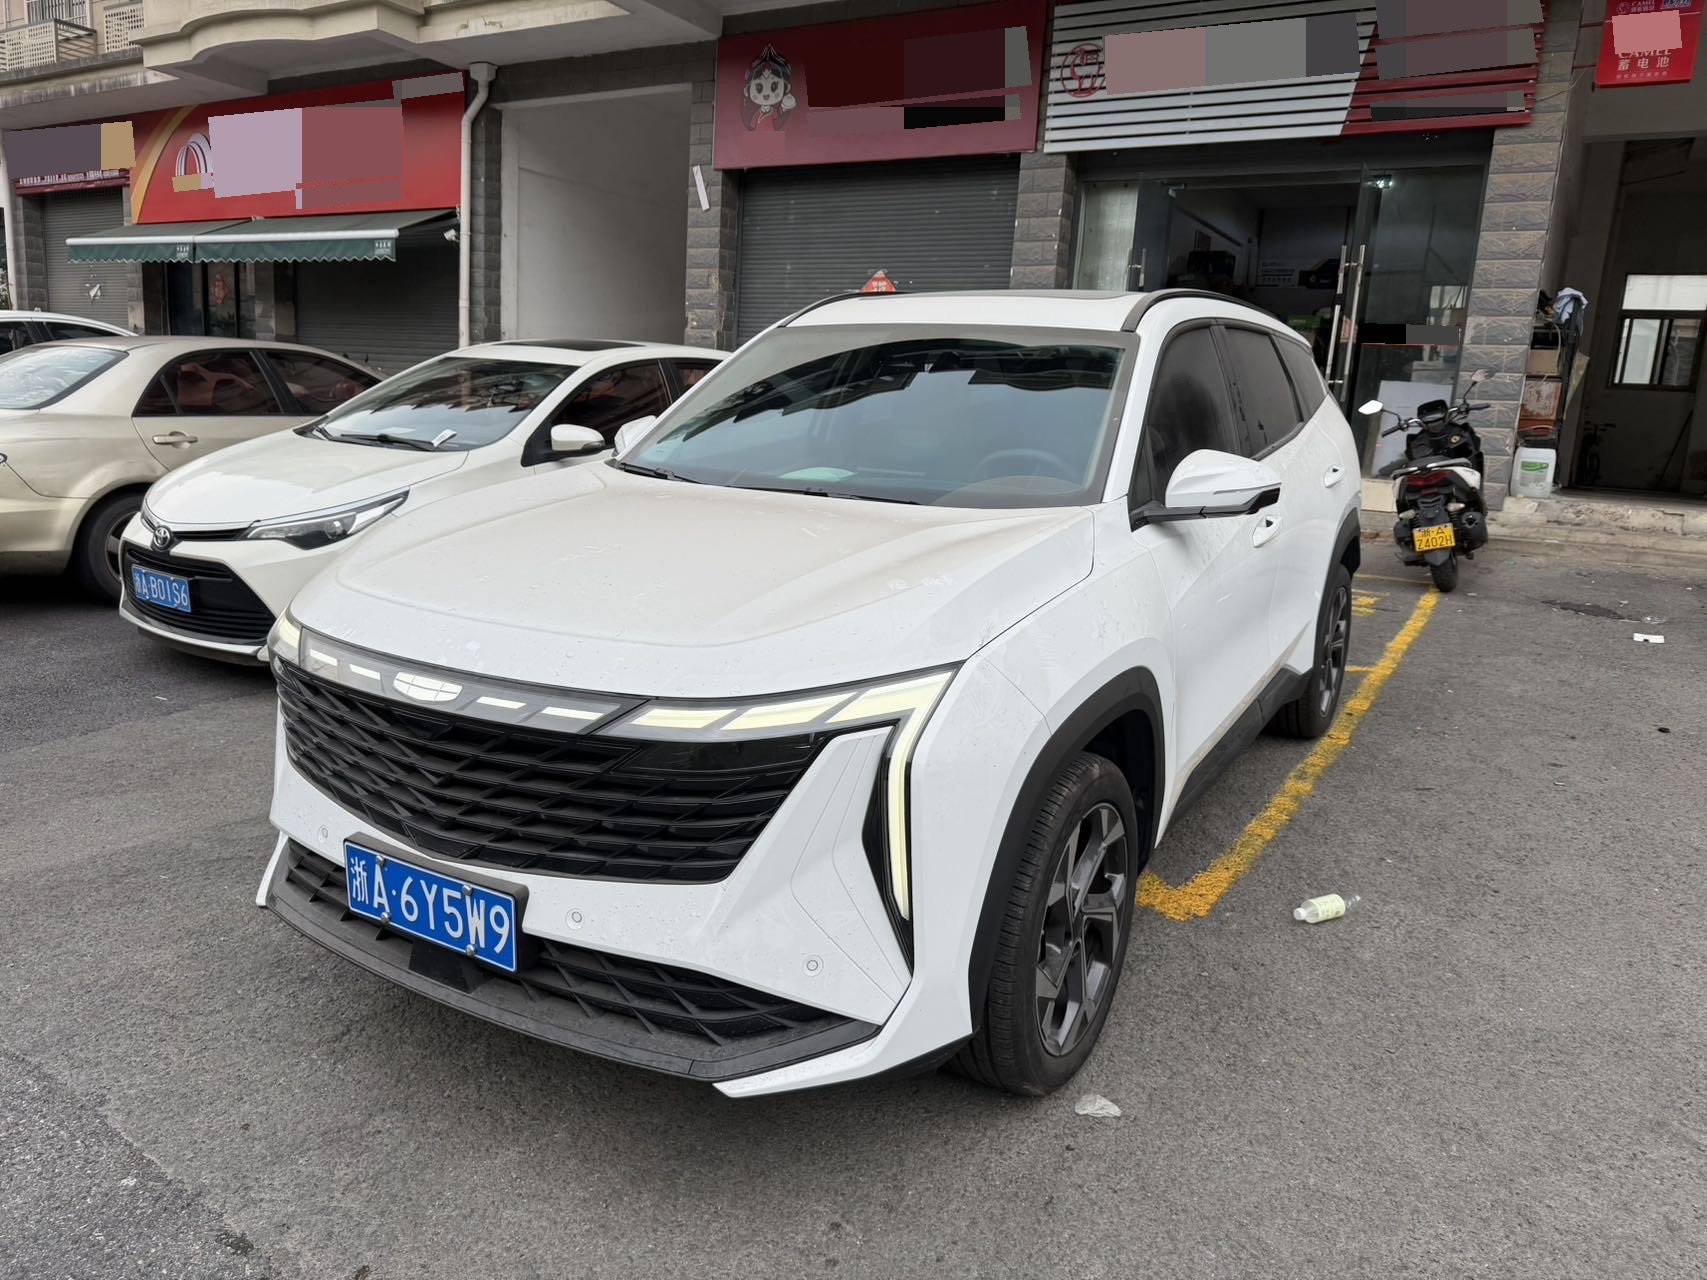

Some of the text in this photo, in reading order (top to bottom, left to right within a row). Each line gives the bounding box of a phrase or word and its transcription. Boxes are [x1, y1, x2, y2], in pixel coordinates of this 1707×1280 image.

[1617, 56, 1671, 71] 蓄电池
[1416, 534, 1453, 550] Z402H
[350, 856, 510, 954] 浙A·6Y5W9
